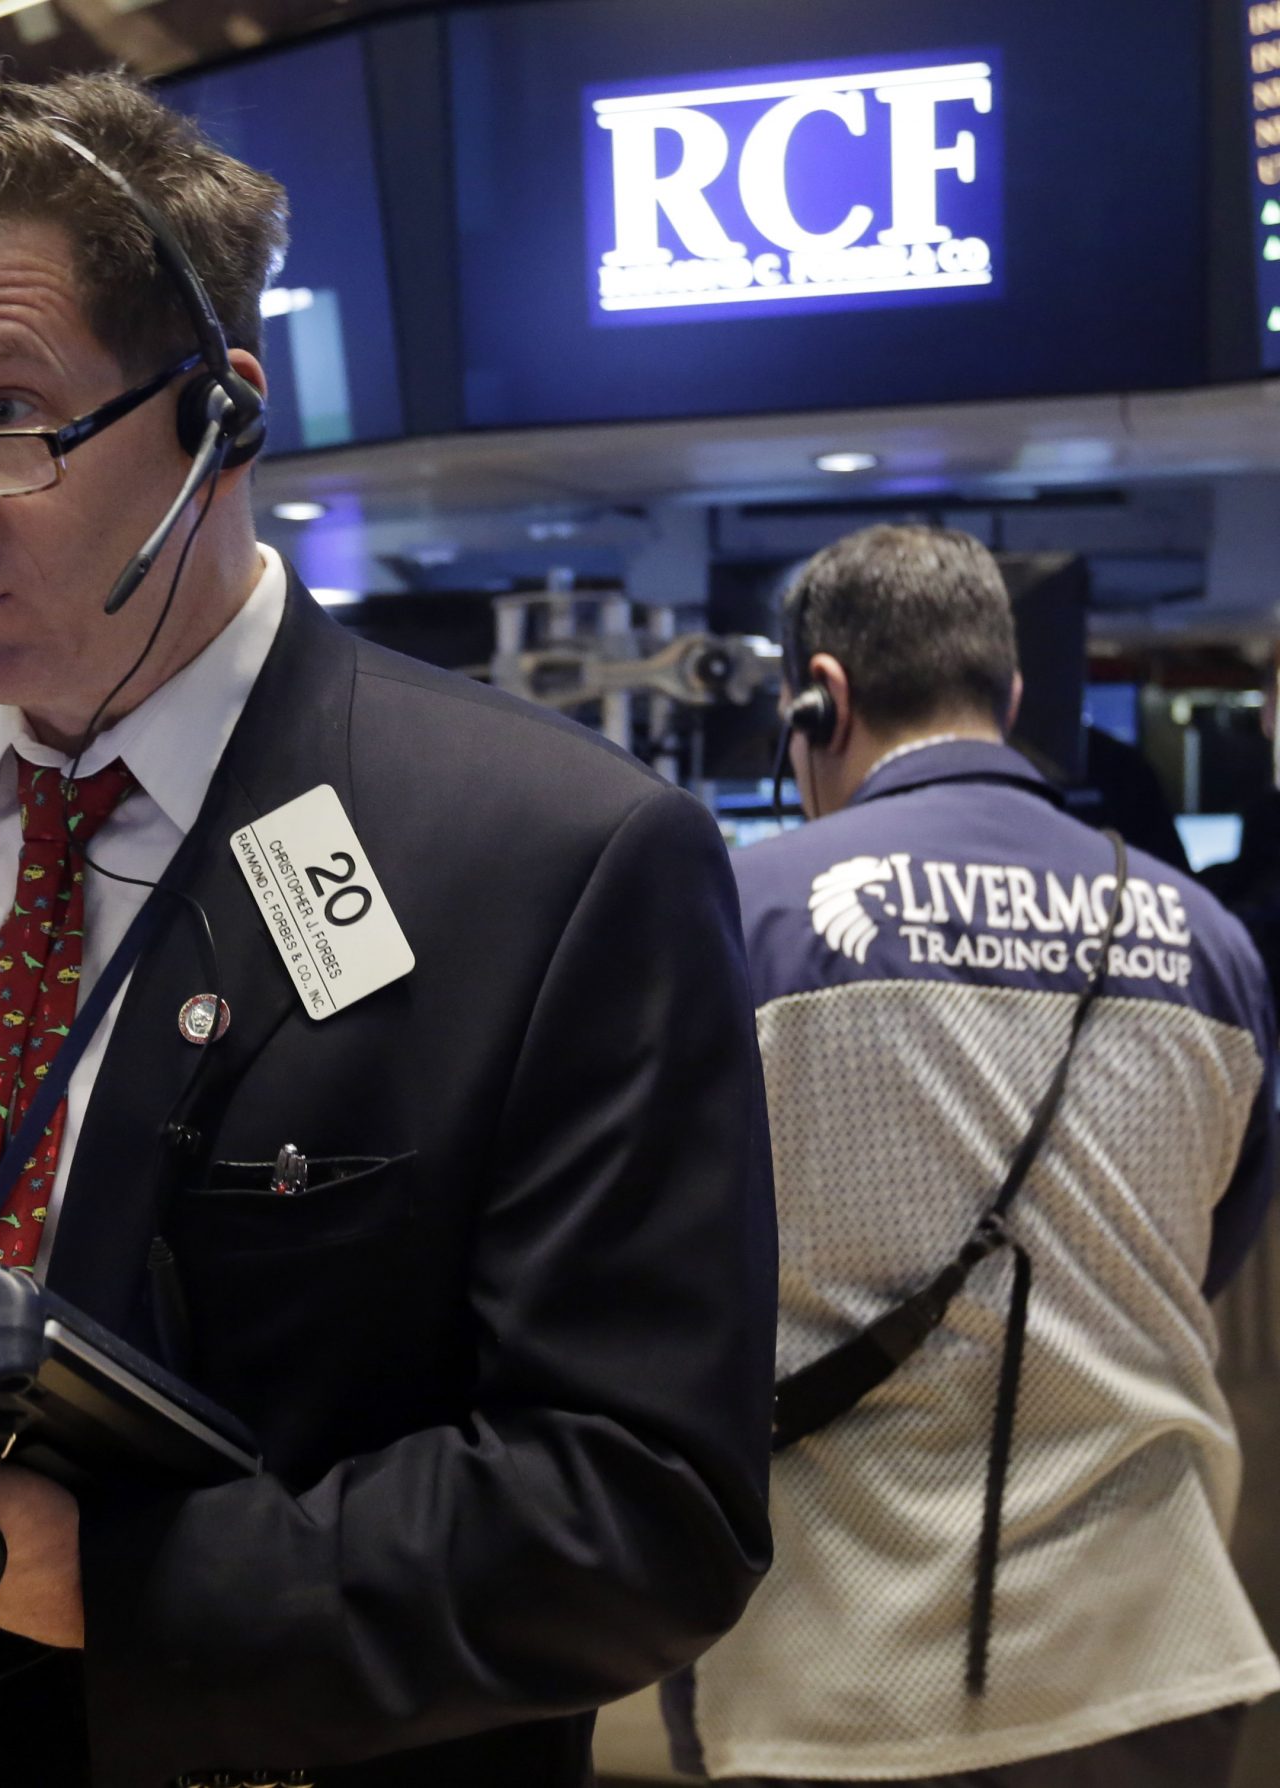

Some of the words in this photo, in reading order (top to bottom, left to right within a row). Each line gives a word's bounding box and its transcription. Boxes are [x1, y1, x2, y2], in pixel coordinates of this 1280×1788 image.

[597, 77, 992, 267] RCF
[269, 839, 314, 920] CHRISTOPHER
[304, 851, 373, 927] 20
[889, 853, 1191, 946] LIVERMORE
[235, 832, 269, 889] RAYMOND
[263, 890, 274, 904] C.
[269, 903, 298, 952] FORBES
[291, 952, 302, 963] &
[308, 988, 325, 1013] INC.
[306, 920, 319, 932] J.
[312, 931, 342, 980] FORBES
[898, 925, 1070, 974] TRADING
